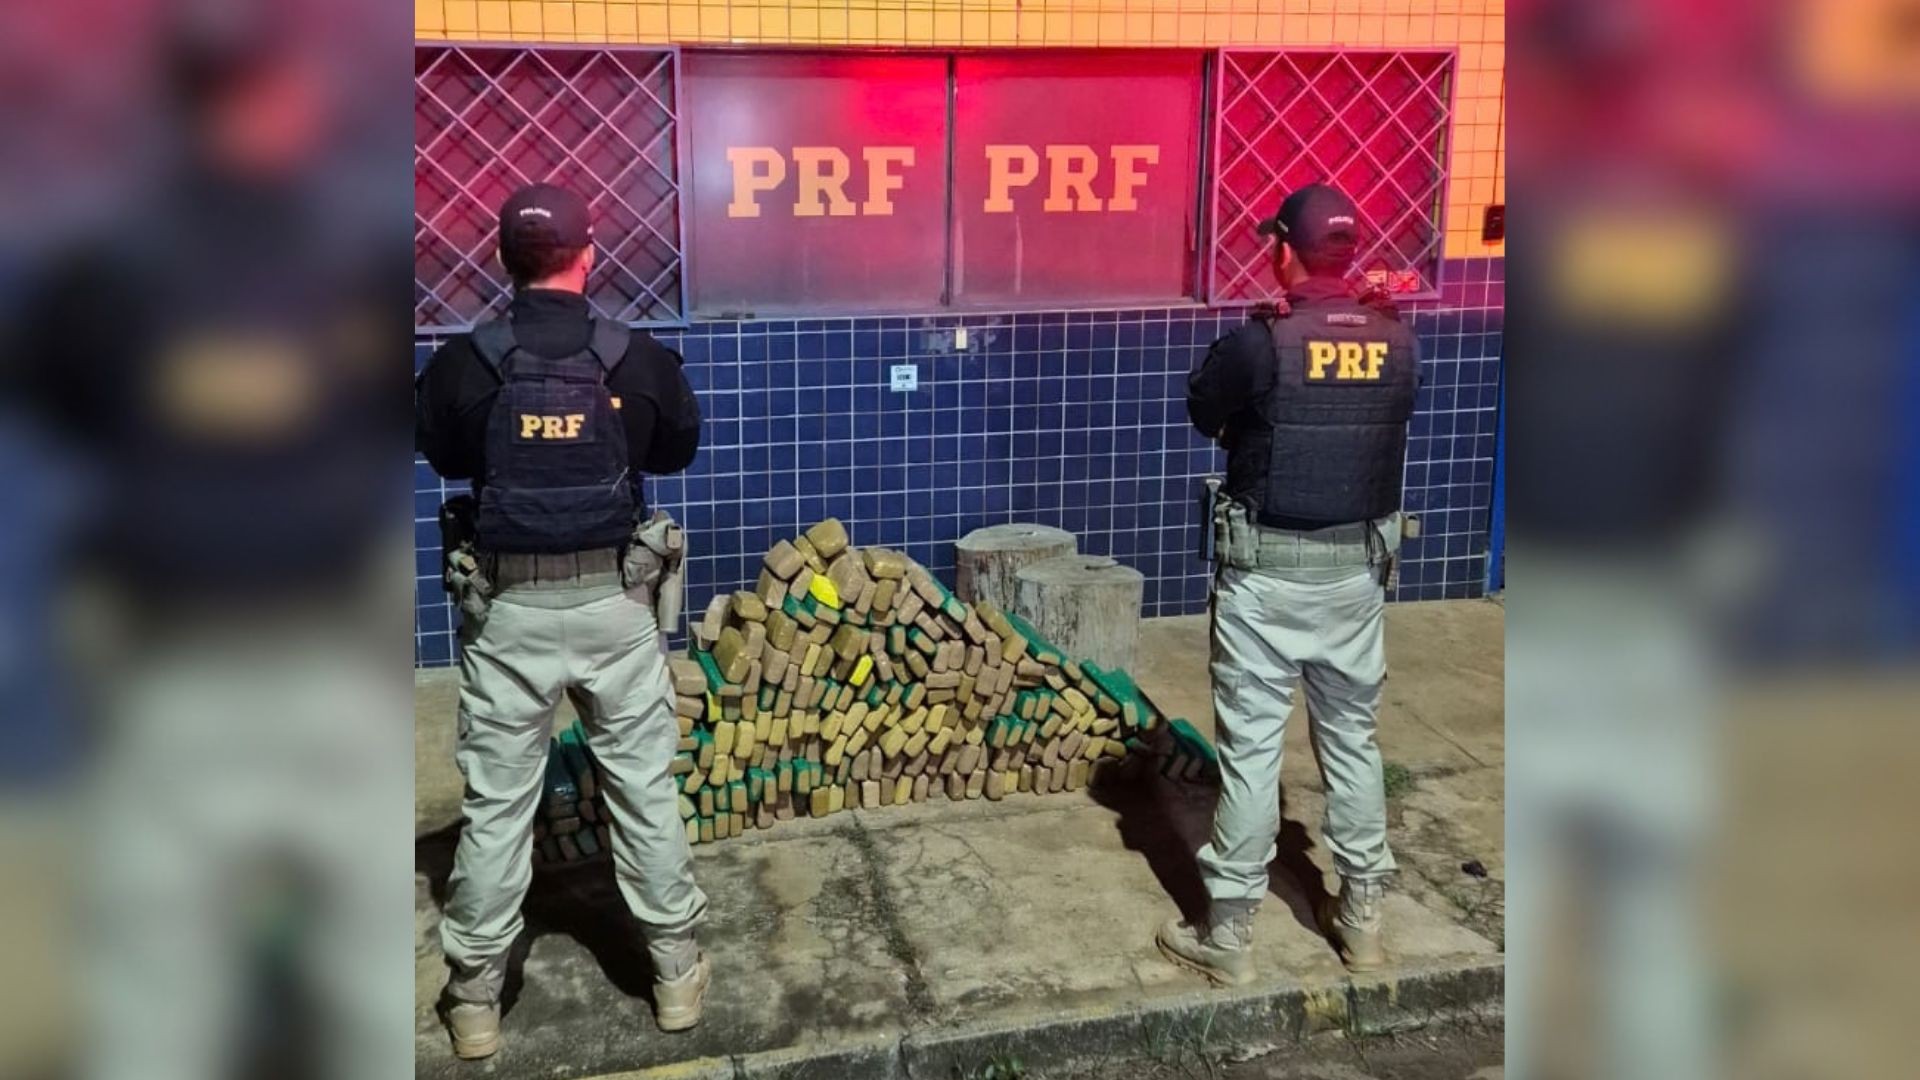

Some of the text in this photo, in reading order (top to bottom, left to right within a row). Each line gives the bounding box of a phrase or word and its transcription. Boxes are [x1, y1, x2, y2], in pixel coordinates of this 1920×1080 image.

[726, 146, 915, 218] PRF
[984, 144, 1160, 213] PRF
[1309, 341, 1388, 379] PRF
[520, 413, 585, 439] PRF
